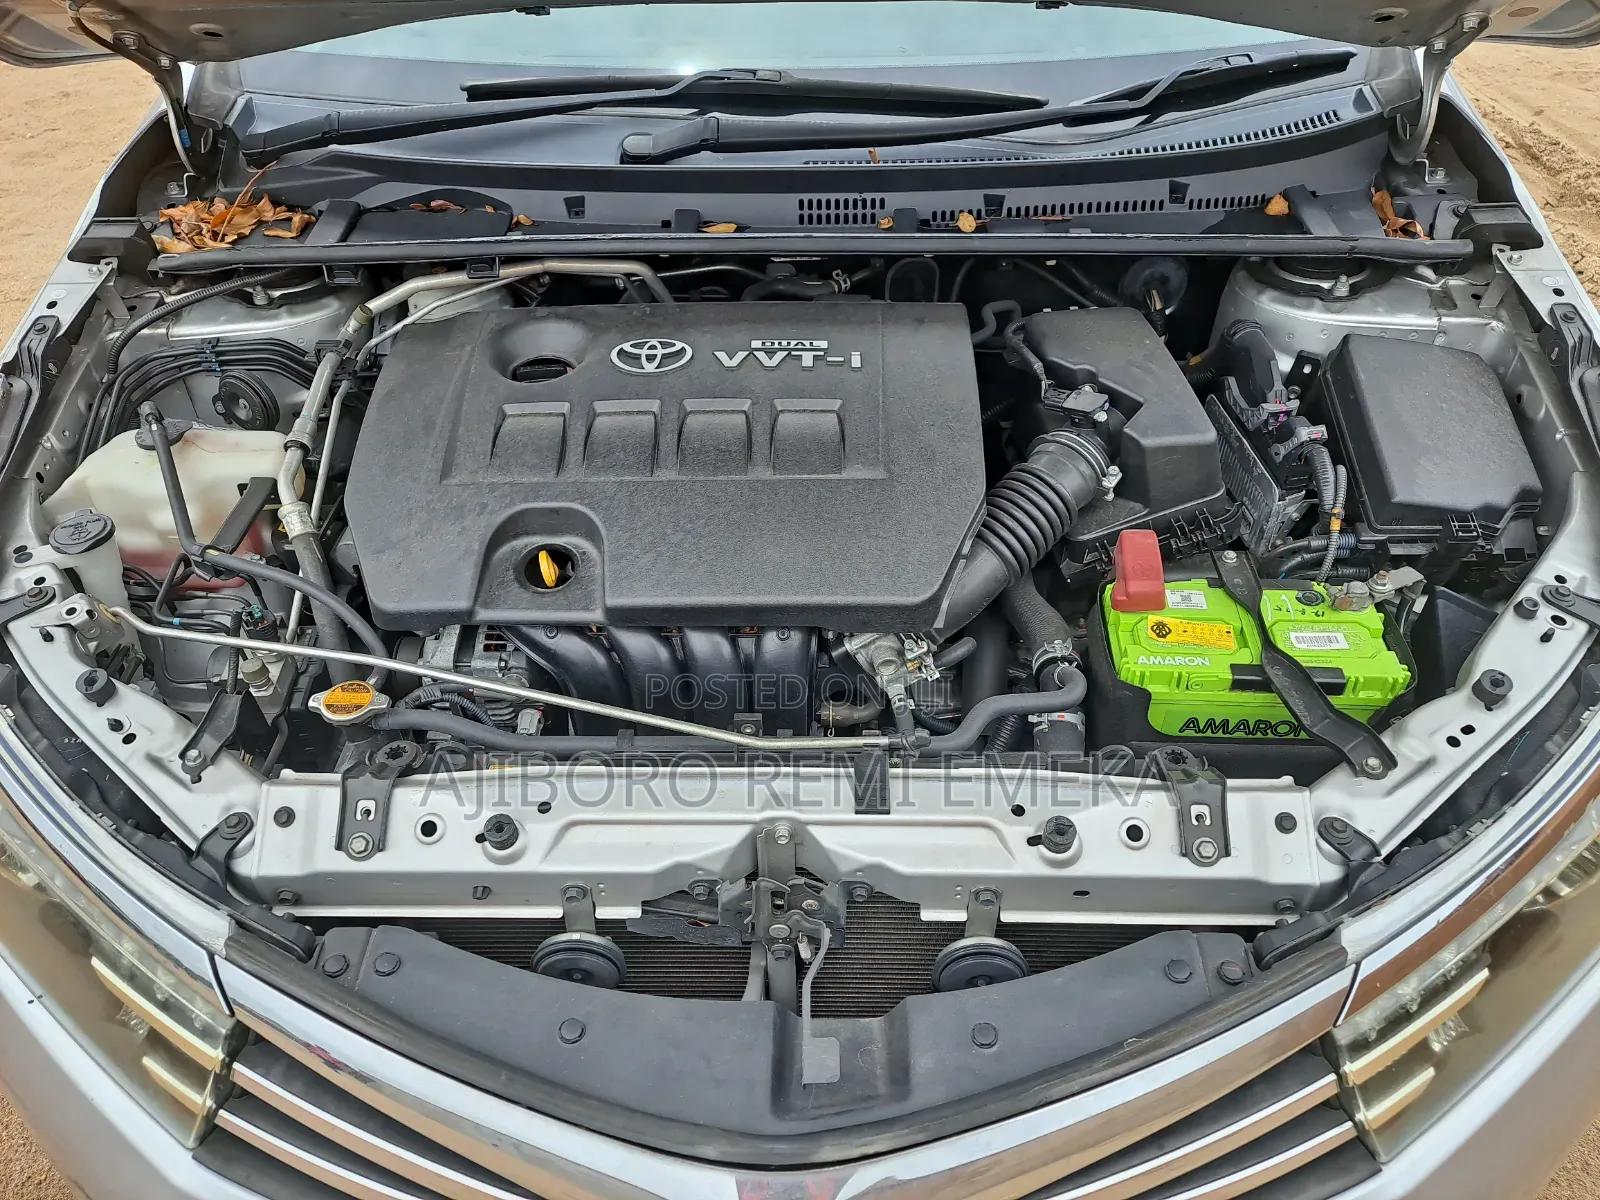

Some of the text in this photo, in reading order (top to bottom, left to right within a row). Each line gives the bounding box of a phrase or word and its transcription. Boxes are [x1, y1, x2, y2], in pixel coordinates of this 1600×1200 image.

[757, 340, 824, 348] DUAL
[713, 350, 863, 369] VVT-i
[1137, 655, 1211, 667] AMARON
